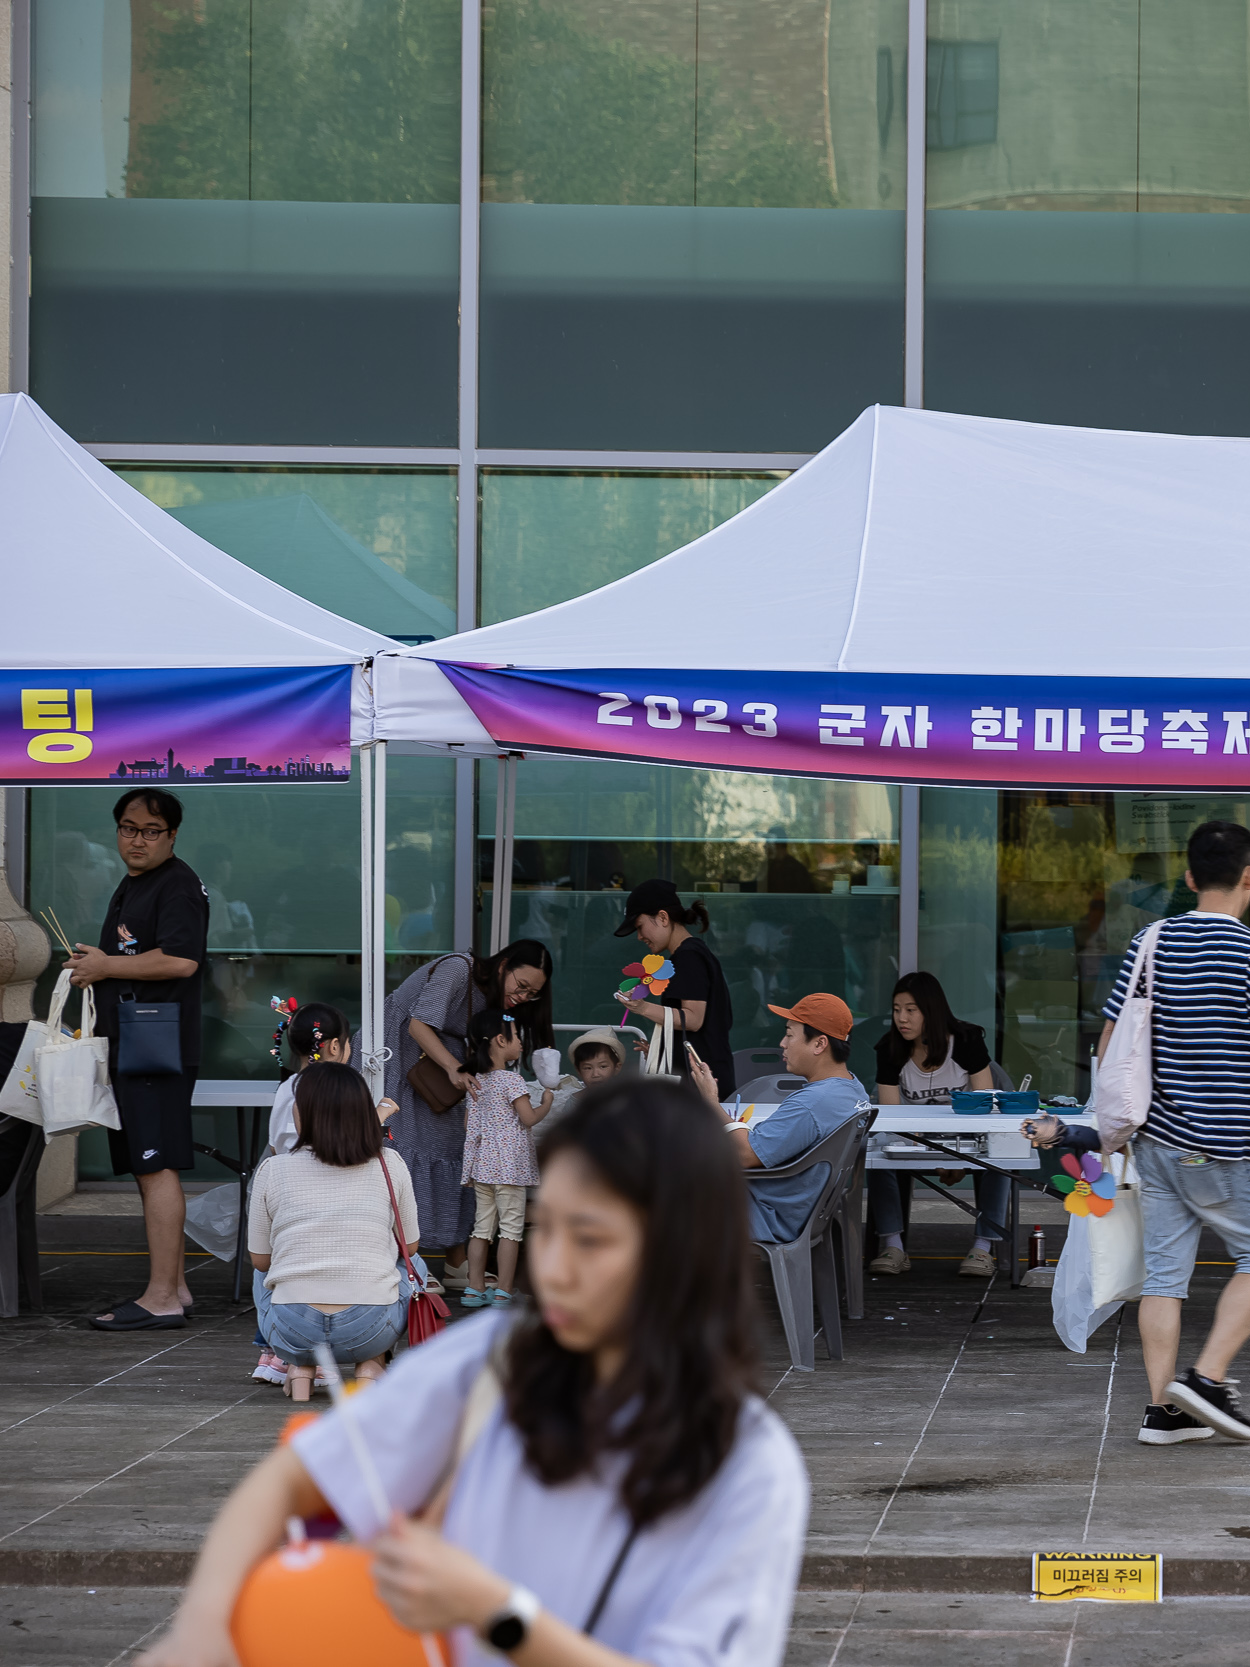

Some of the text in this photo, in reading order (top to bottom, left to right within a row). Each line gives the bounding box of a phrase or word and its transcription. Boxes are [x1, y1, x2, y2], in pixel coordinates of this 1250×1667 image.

[21, 688, 93, 764] 팅
[597, 691, 778, 738] 2023
[818, 704, 933, 749] 군자
[287, 763, 334, 776] GUNJA
[1053, 1568, 1142, 1583] 미끄러짐 주의
